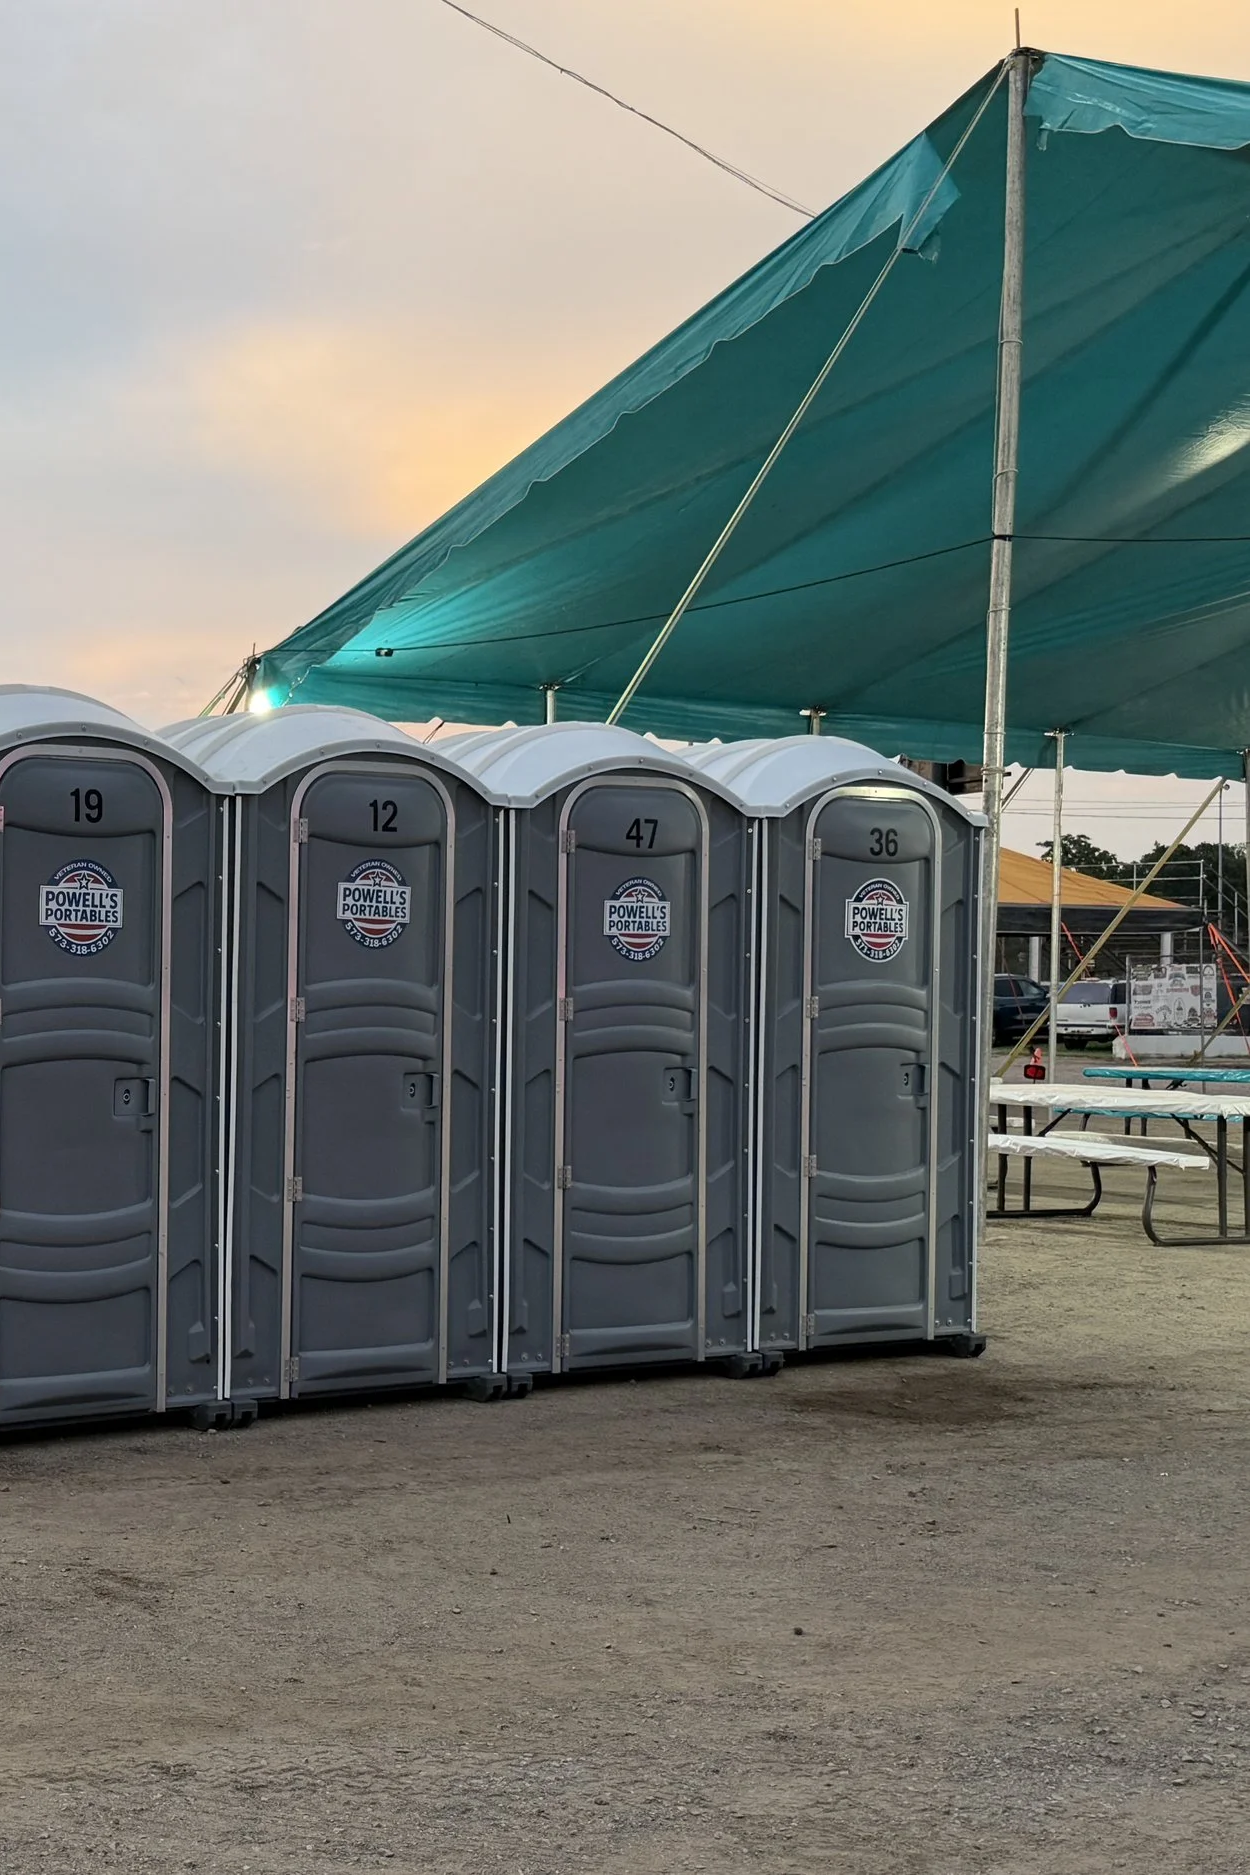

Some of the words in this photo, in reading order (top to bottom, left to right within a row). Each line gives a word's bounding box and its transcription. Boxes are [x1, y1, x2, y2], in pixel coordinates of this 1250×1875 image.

[70, 788, 103, 823] 19
[369, 799, 398, 832] 12
[625, 818, 658, 849] 47
[869, 827, 898, 857] 36
[54, 862, 87, 880] VETERAN
[88, 862, 112, 883] OWNED
[350, 861, 380, 878] VETERAN
[381, 862, 402, 881] OWNED
[342, 887, 407, 906] POWELL'S
[615, 879, 643, 896] VETERAN
[45, 890, 118, 909] POWELL'S
[45, 907, 119, 923] PORTABLES
[342, 903, 407, 919] PORTABLES
[609, 905, 667, 920] POWELL'S
[852, 906, 904, 922] POWELL'S
[345, 921, 403, 948] 573-318-6302
[609, 920, 667, 932] PORTABLES
[852, 921, 904, 933] PORTABLES
[48, 927, 115, 955] 573-318-6302
[611, 937, 664, 960] 573-318-6302
[855, 938, 901, 959] 573-318-6302
